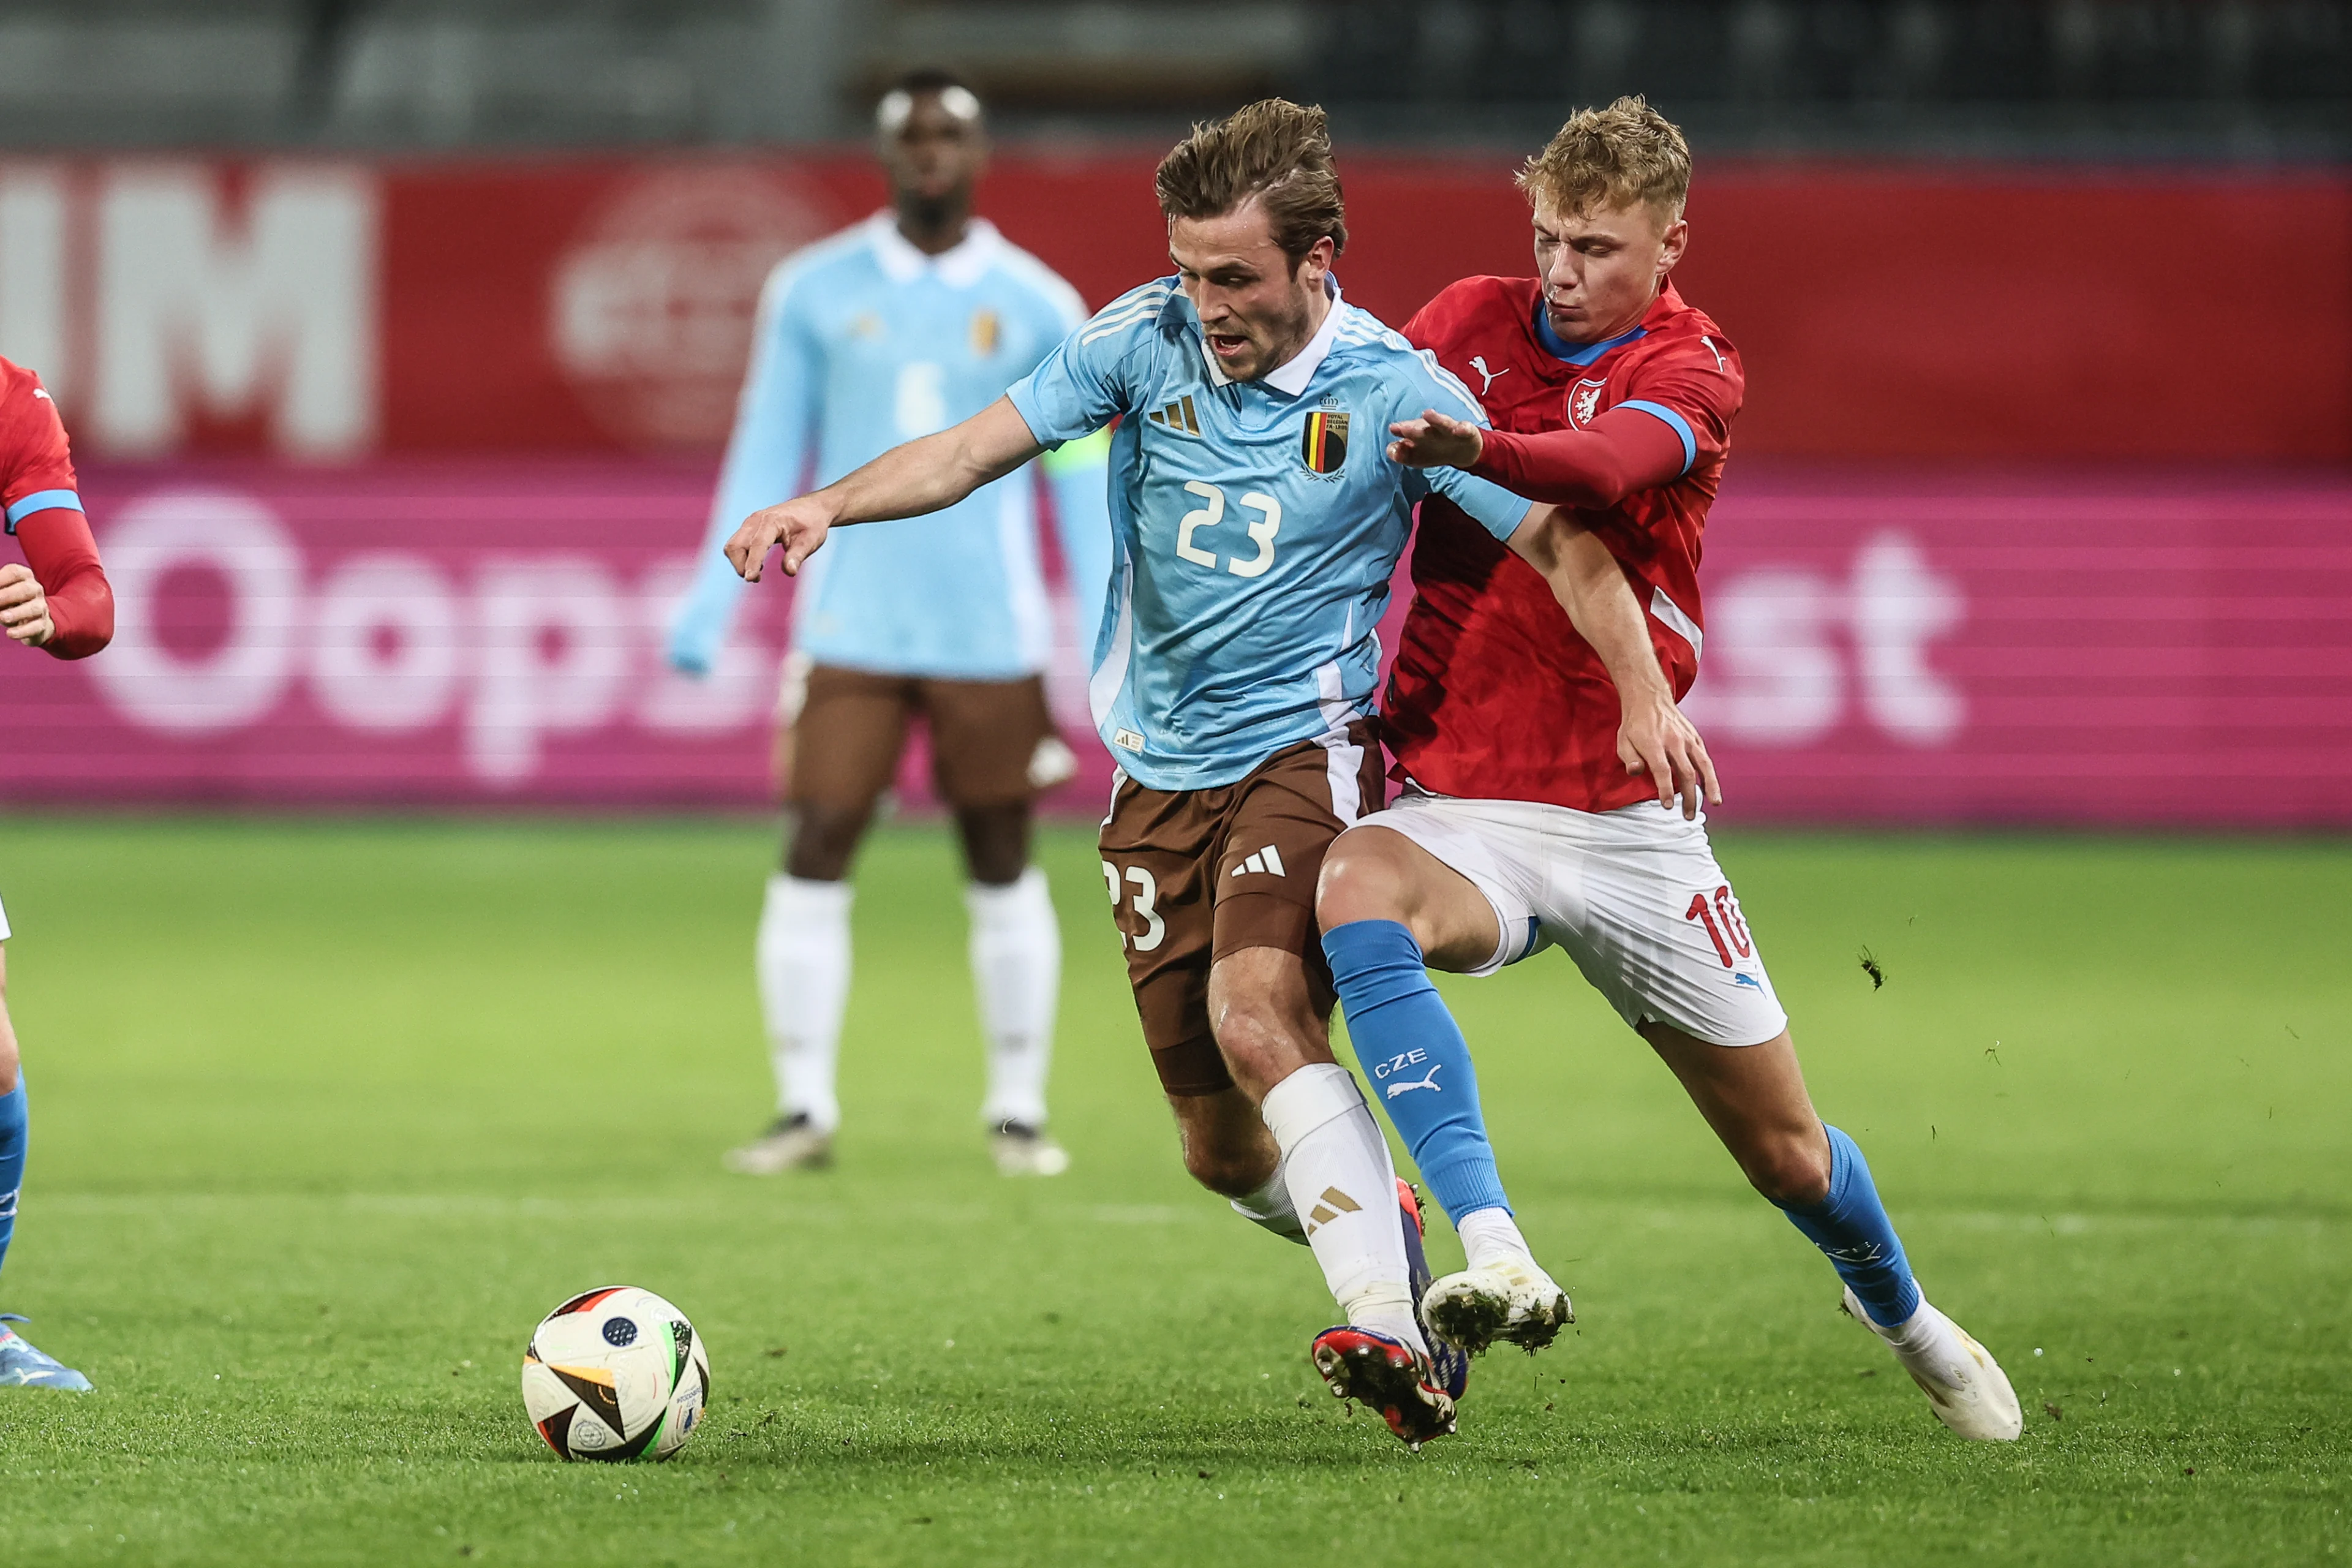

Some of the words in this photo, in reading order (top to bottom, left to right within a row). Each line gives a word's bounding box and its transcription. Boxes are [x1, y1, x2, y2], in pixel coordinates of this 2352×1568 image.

[1176, 480, 1282, 578] 23
[86, 485, 781, 786] Oops
[1676, 532, 1966, 746] st
[1685, 885, 1751, 968] 10
[1374, 1047, 1428, 1080] CZE
